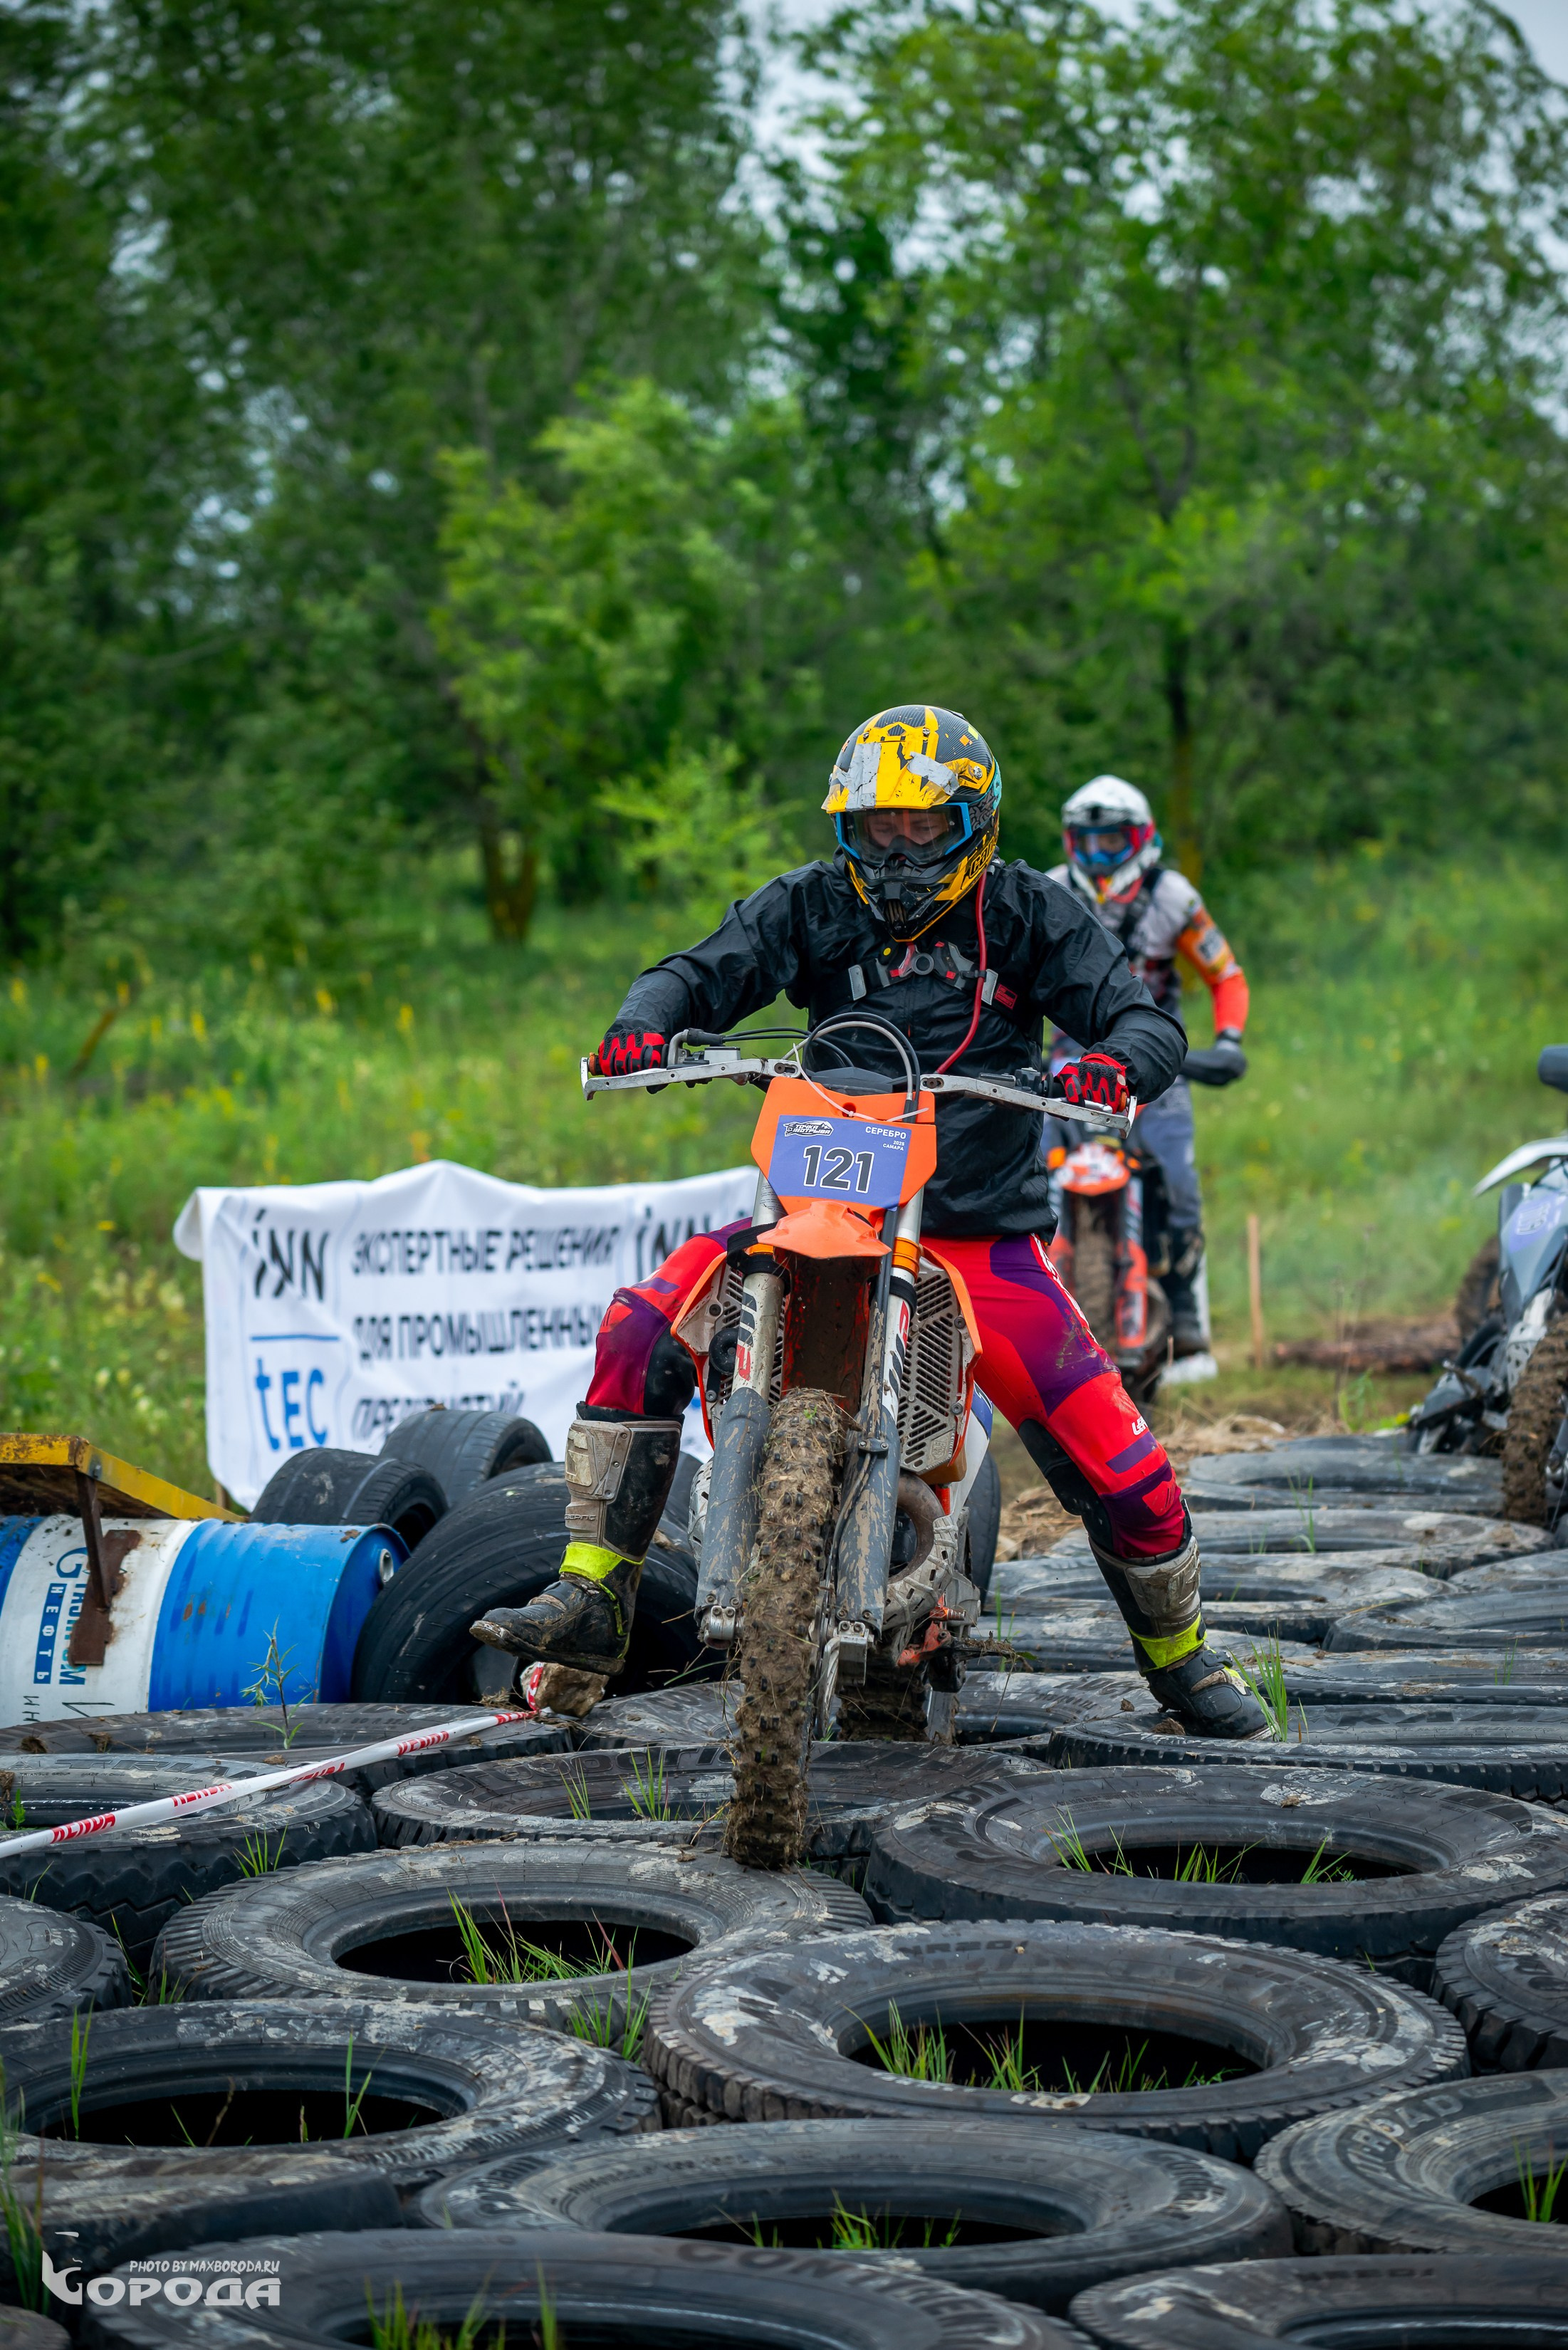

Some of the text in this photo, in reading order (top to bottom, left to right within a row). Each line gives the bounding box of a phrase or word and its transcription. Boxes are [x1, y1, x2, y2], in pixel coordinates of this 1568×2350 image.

[865, 1126, 906, 1139] СЕРЕБРО
[803, 1145, 874, 1194] 121
[351, 1224, 620, 1275] ЭКСПЕРТНЫЕ РЕШЕНИЯ
[354, 1302, 602, 1368] ДЛЯ ПРОМЫШЛЕННЫ
[36, 1585, 65, 1681] НЕФТЬ
[1283, 1768, 1444, 1800] CONTROL
